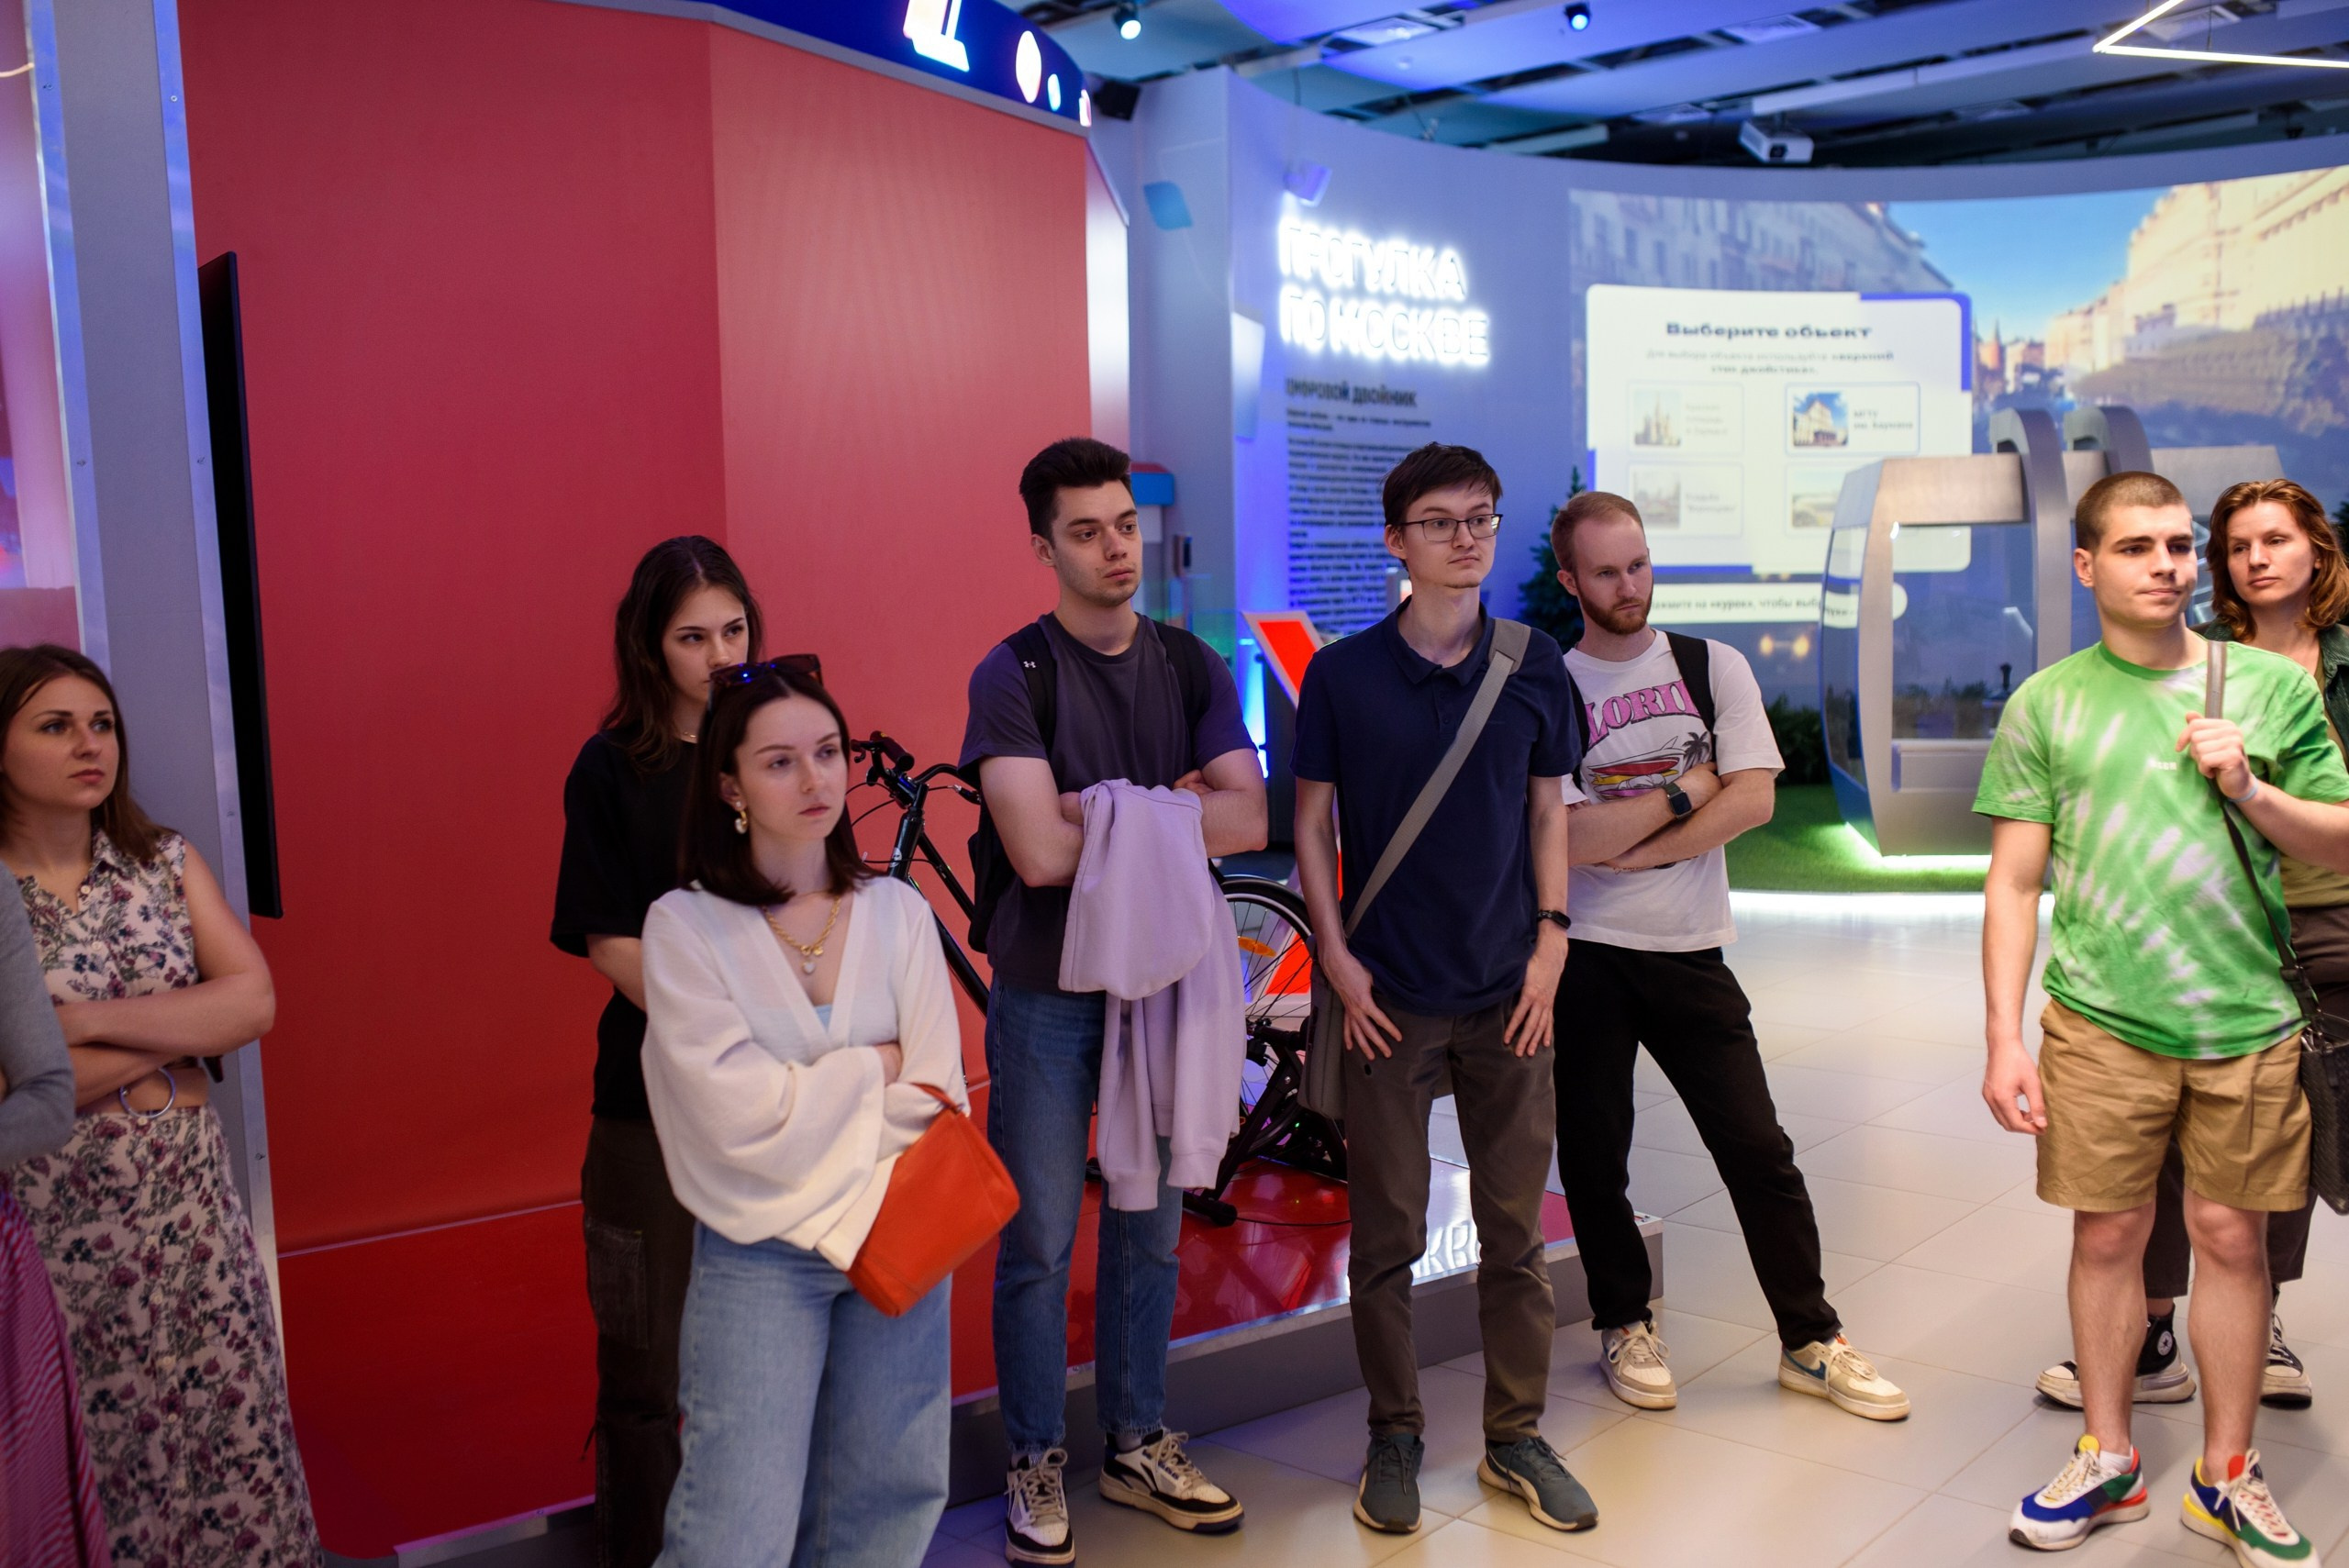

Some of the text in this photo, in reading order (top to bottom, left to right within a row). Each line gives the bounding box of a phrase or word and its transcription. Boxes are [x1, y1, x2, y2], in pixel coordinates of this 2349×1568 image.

[1279, 222, 1468, 302] ПРОГУЛКА
[1280, 284, 1490, 365] ПО МОСКВЕ
[1666, 321, 1779, 340] Выберите
